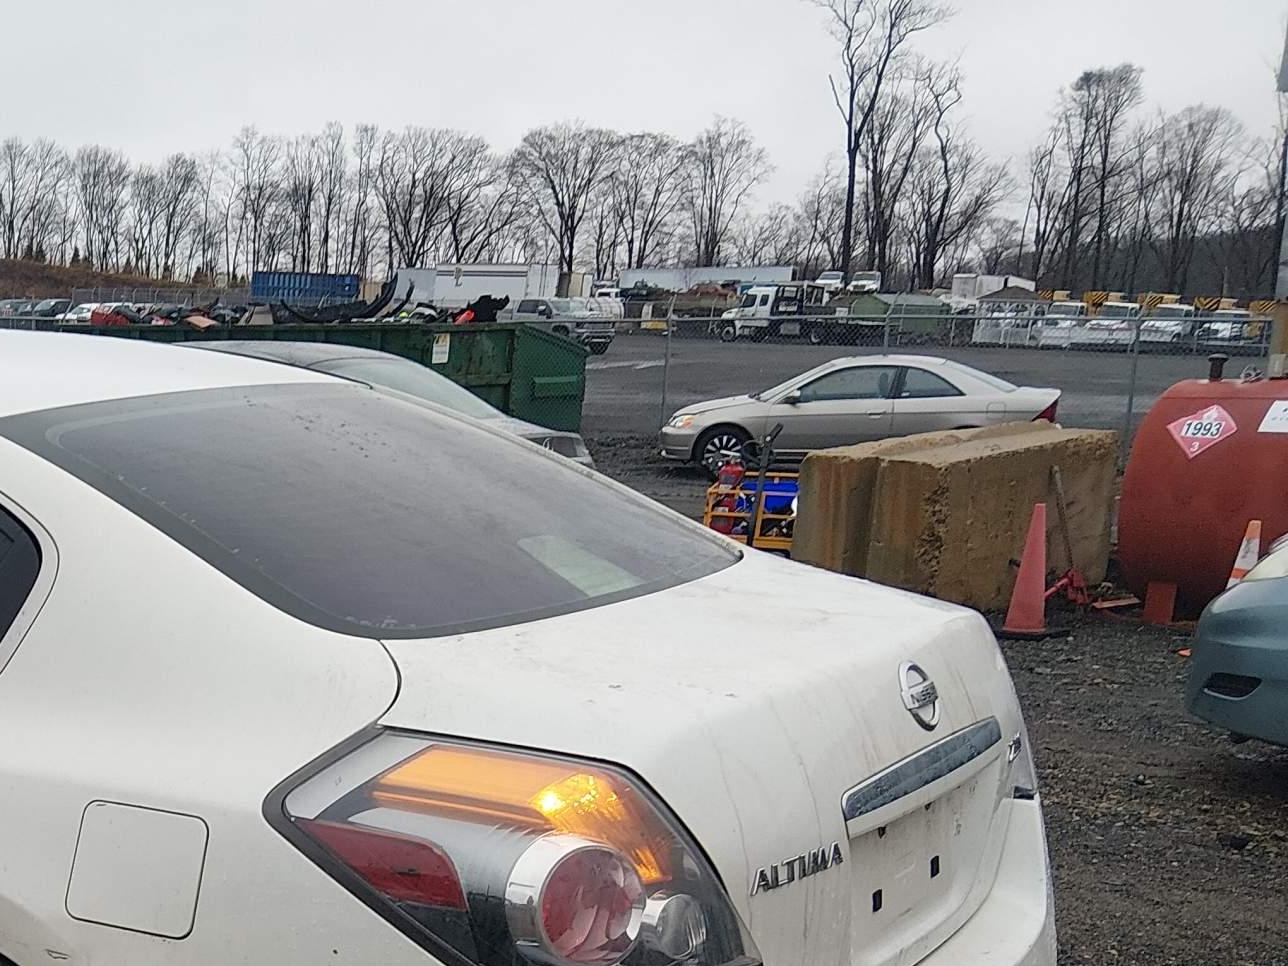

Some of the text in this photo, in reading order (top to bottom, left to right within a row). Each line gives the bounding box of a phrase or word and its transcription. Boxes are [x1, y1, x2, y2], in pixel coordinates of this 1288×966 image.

[1183, 421, 1223, 437] 1993
[1189, 441, 1200, 452] 3
[749, 840, 844, 897] ALTIMA
